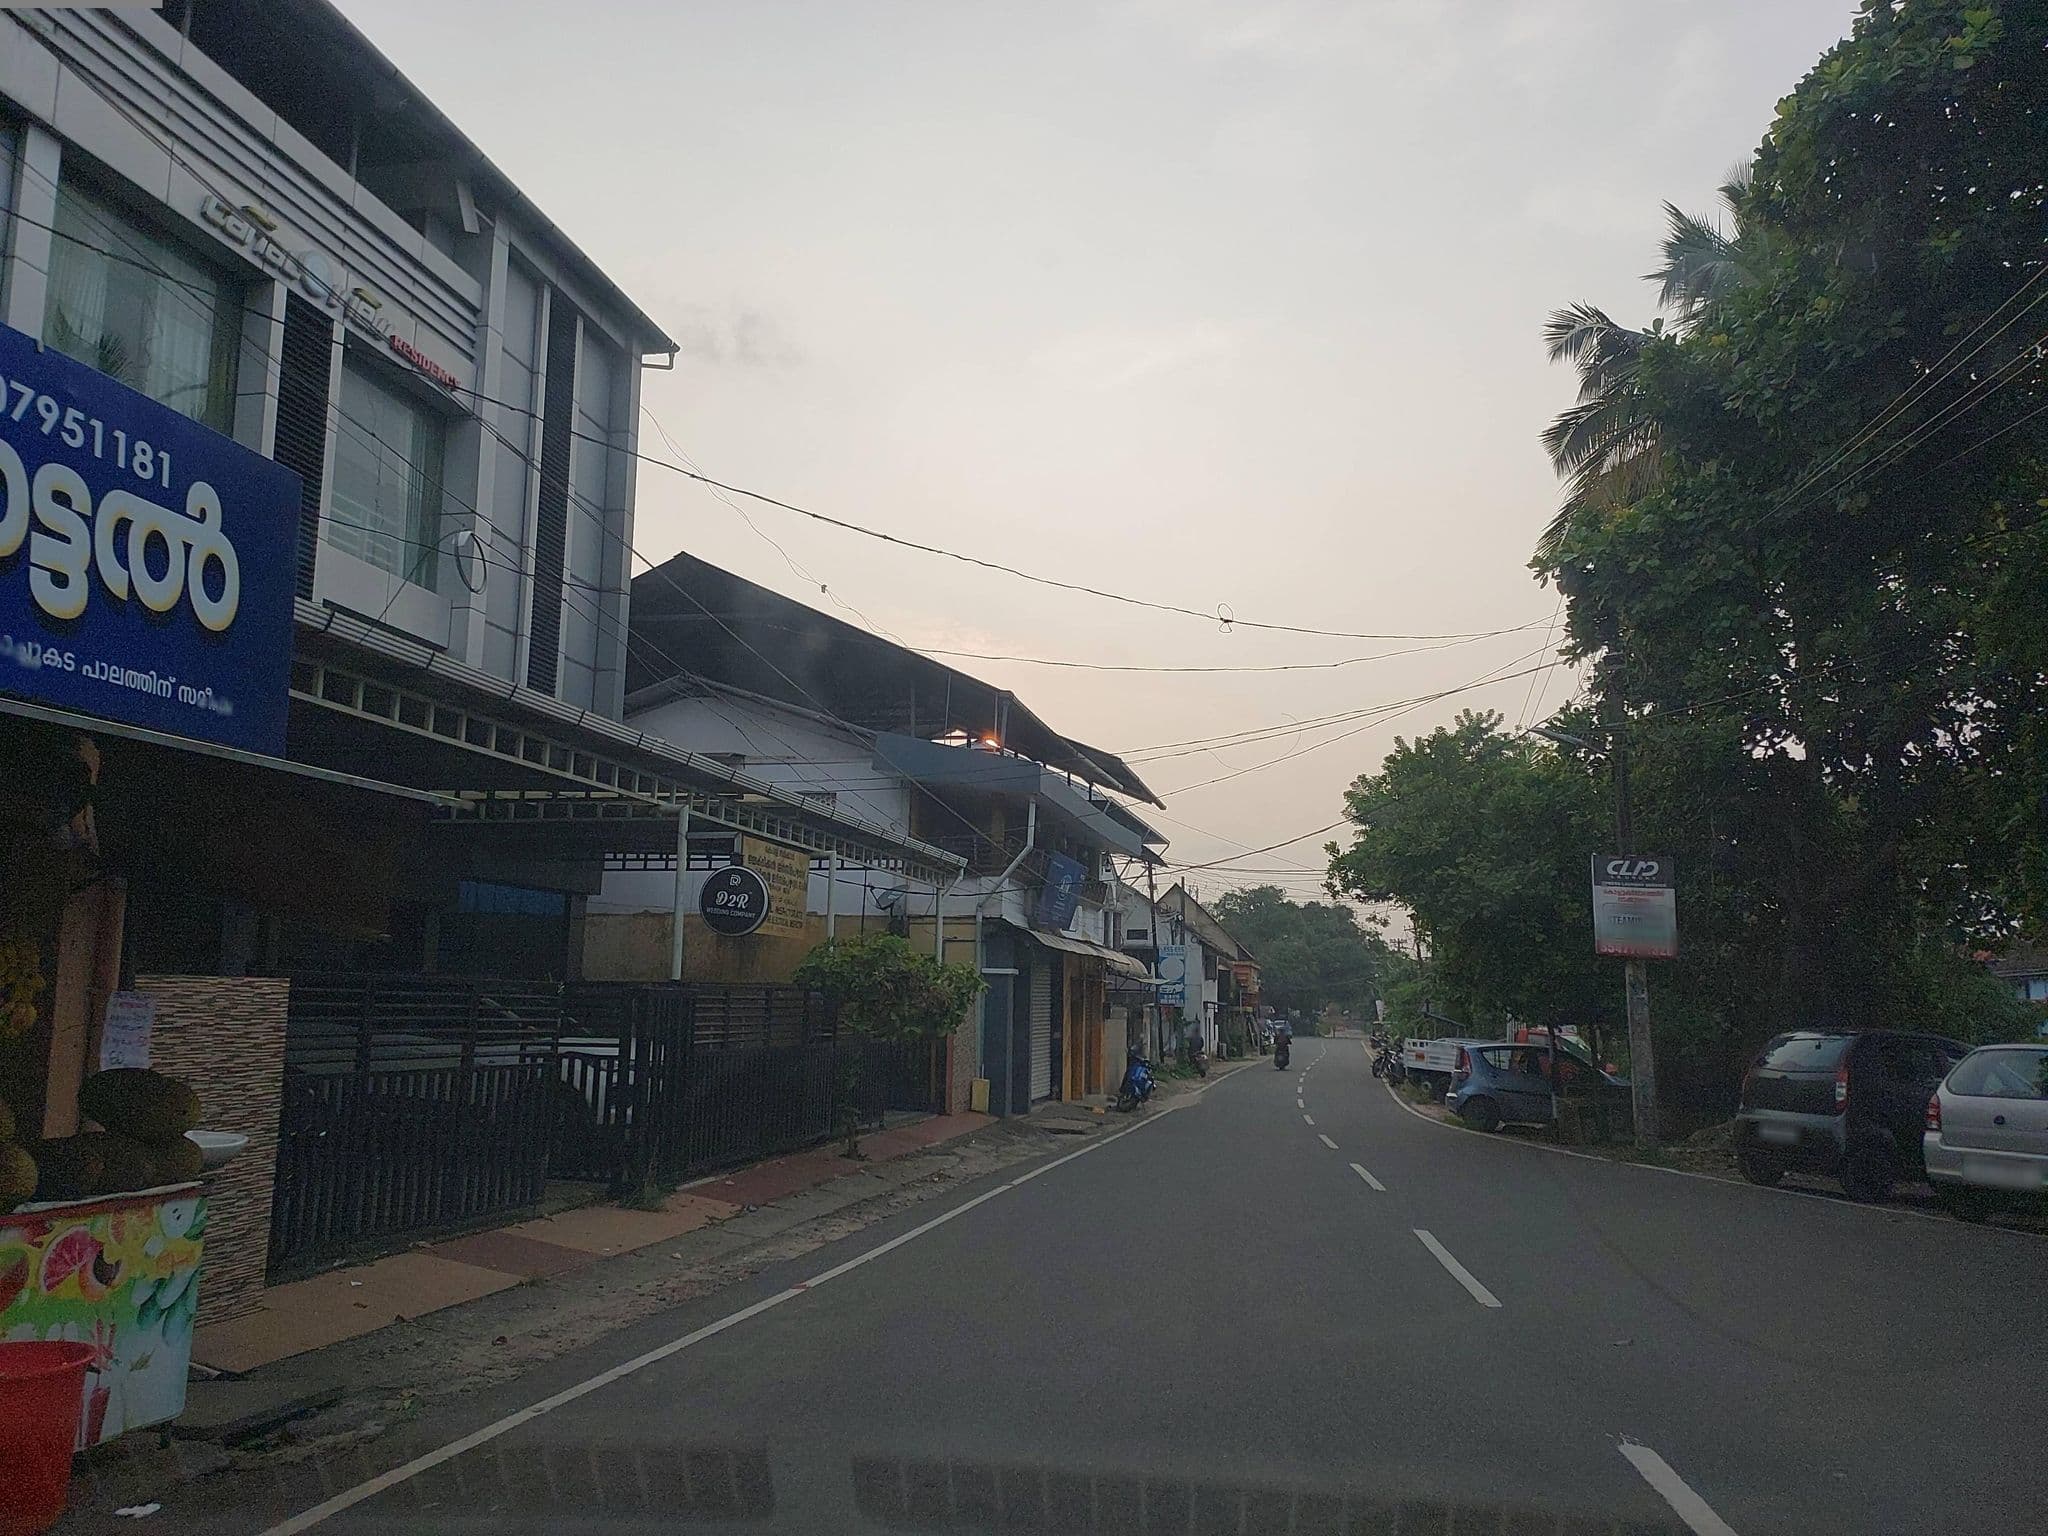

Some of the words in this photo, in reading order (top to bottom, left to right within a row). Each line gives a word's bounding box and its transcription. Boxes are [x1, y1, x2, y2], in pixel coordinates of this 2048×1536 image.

[389, 334, 462, 388] RESIDENCY
[0, 373, 171, 488] 7951181
[706, 907, 730, 916] WEDDING
[730, 910, 756, 919] COMPANY
[715, 890, 749, 909] D2R
